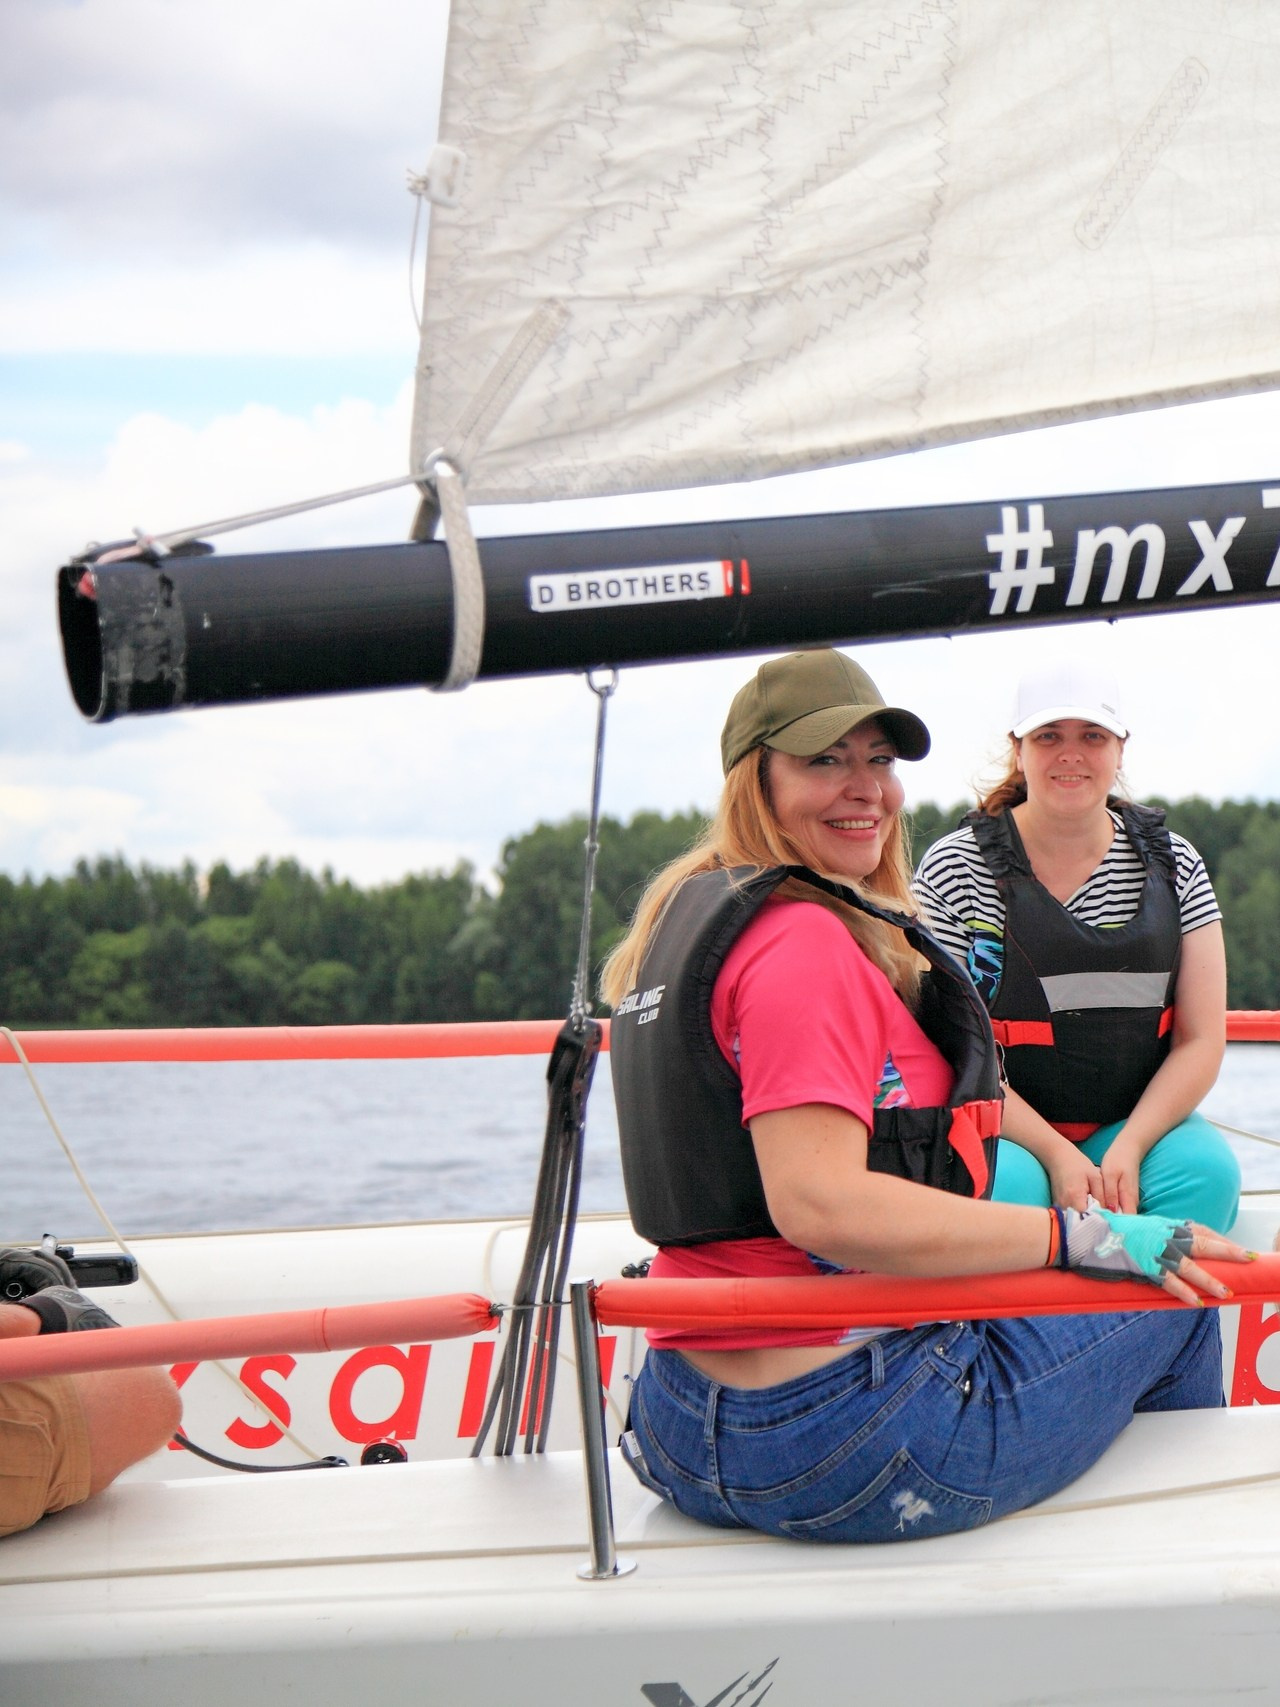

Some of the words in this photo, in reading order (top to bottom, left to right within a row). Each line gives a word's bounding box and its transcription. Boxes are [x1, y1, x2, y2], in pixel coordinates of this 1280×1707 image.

[538, 586, 554, 604] D
[568, 572, 711, 602] BROTHERS
[638, 1008, 660, 1025] CLUB
